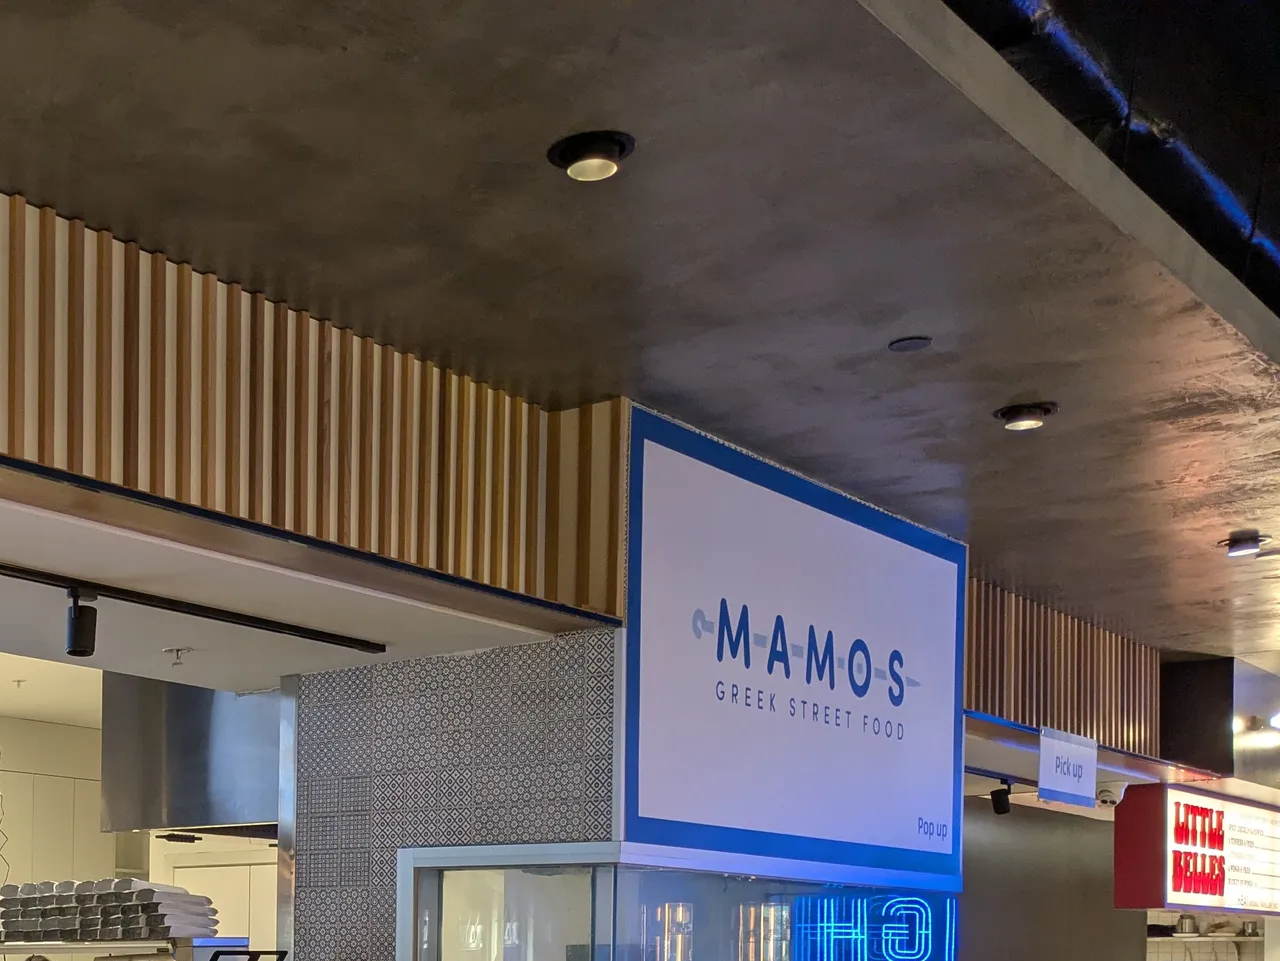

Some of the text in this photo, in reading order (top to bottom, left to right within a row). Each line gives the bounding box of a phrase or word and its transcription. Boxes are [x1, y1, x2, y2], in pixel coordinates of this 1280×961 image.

[716, 597, 905, 707] MAMOS
[716, 681, 904, 741] GREEK STREET FOOD
[1055, 756, 1083, 783] Pick up
[918, 816, 947, 840] Pop up
[1174, 801, 1225, 851] LITTLE
[1172, 850, 1225, 896] BELLES
